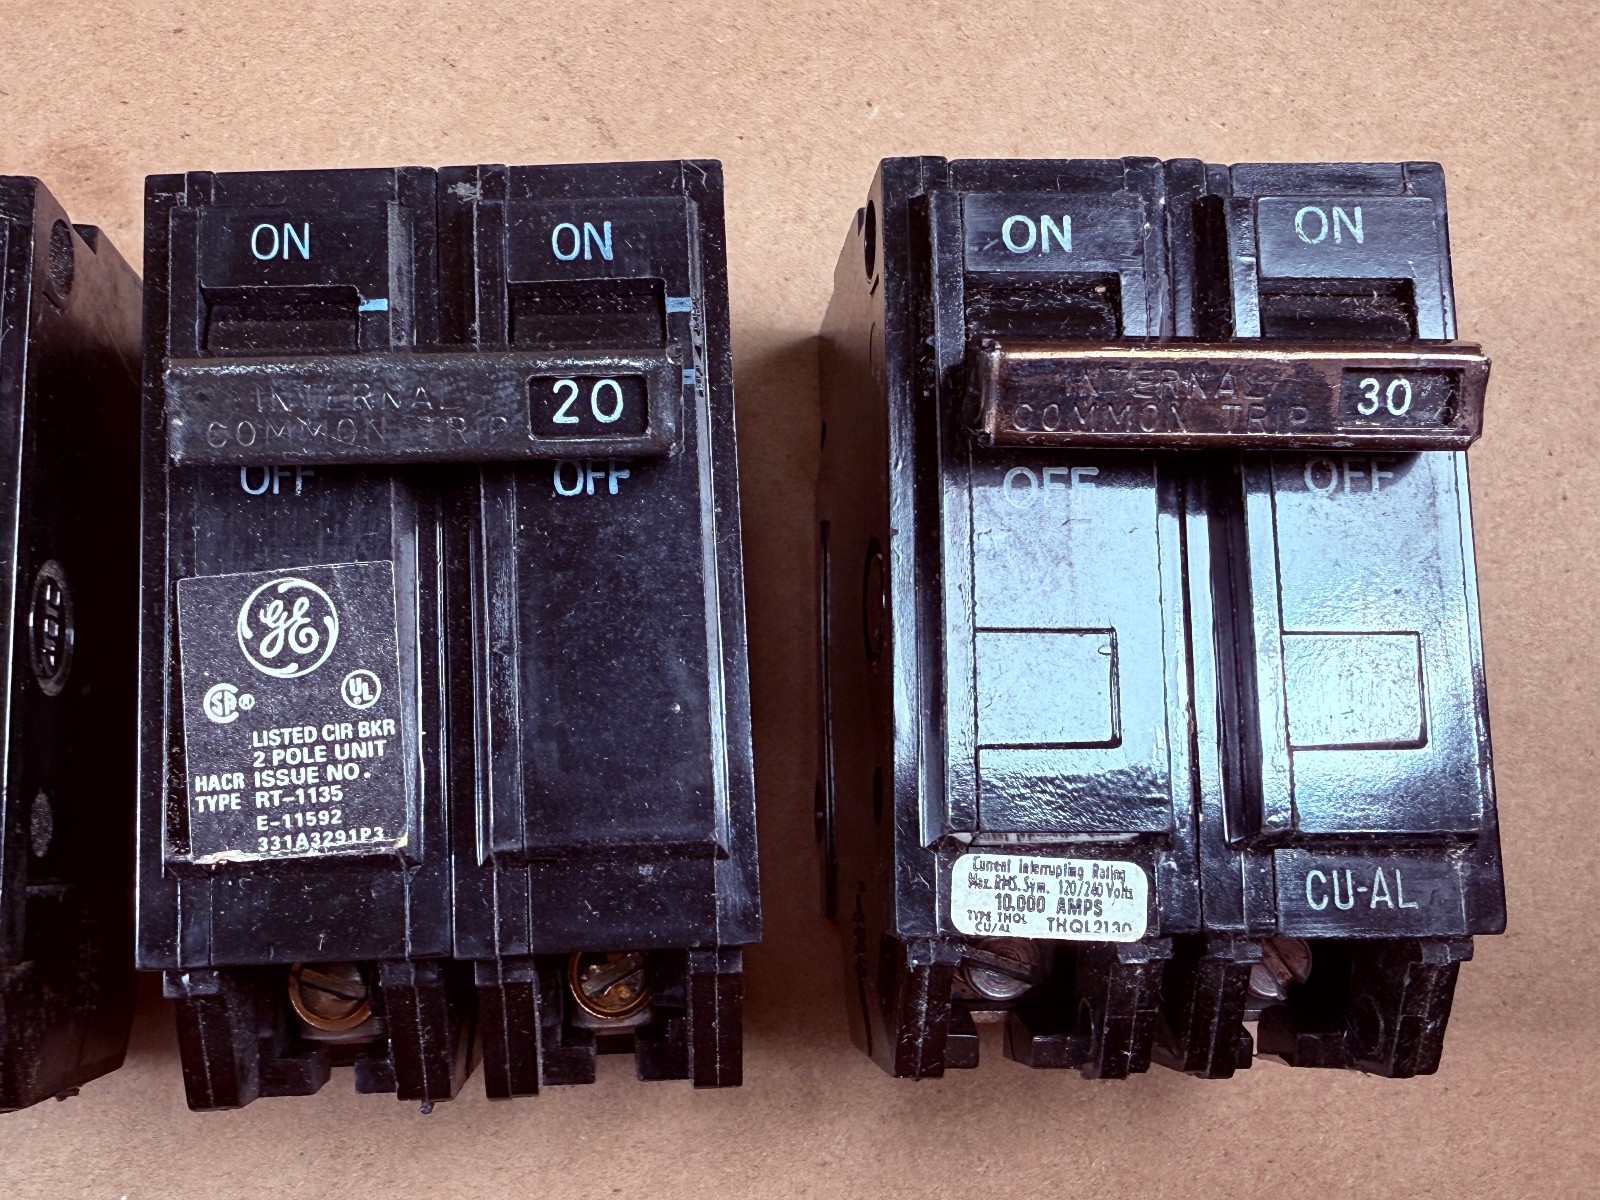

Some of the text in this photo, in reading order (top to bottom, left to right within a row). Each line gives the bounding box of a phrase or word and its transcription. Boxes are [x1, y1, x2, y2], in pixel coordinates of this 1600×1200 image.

[1001, 214, 1073, 254] ON
[1294, 206, 1365, 245] ON
[252, 222, 311, 261] ON
[551, 221, 613, 262] ON
[255, 383, 462, 413] INERNAL
[1062, 368, 1269, 400] NTERNAL
[1356, 377, 1412, 416] 30
[552, 378, 624, 425] 20
[206, 417, 387, 449] COMMON
[1012, 403, 1311, 434] COMMON TRIP
[240, 465, 315, 496] OFF
[553, 459, 631, 497] OFF
[1003, 466, 1100, 508] OFF
[1303, 456, 1396, 500] OFF
[252, 718, 397, 748] LISTED CIR BKR
[253, 739, 387, 768] 2 POLE UNIT
[195, 772, 246, 793] HACR
[253, 762, 372, 788] ISSUE NO.
[195, 792, 242, 814] TYPE
[255, 784, 344, 809] RT-1135
[256, 808, 343, 831] E-11592
[257, 826, 385, 852] 331A3291P3
[972, 855, 1127, 884] Current Interrupting Rating
[1105, 881, 1134, 900] Volts
[1305, 866, 1419, 911] CU-AL
[966, 908, 992, 923] TYPE
[1055, 896, 1104, 918] AMPS
